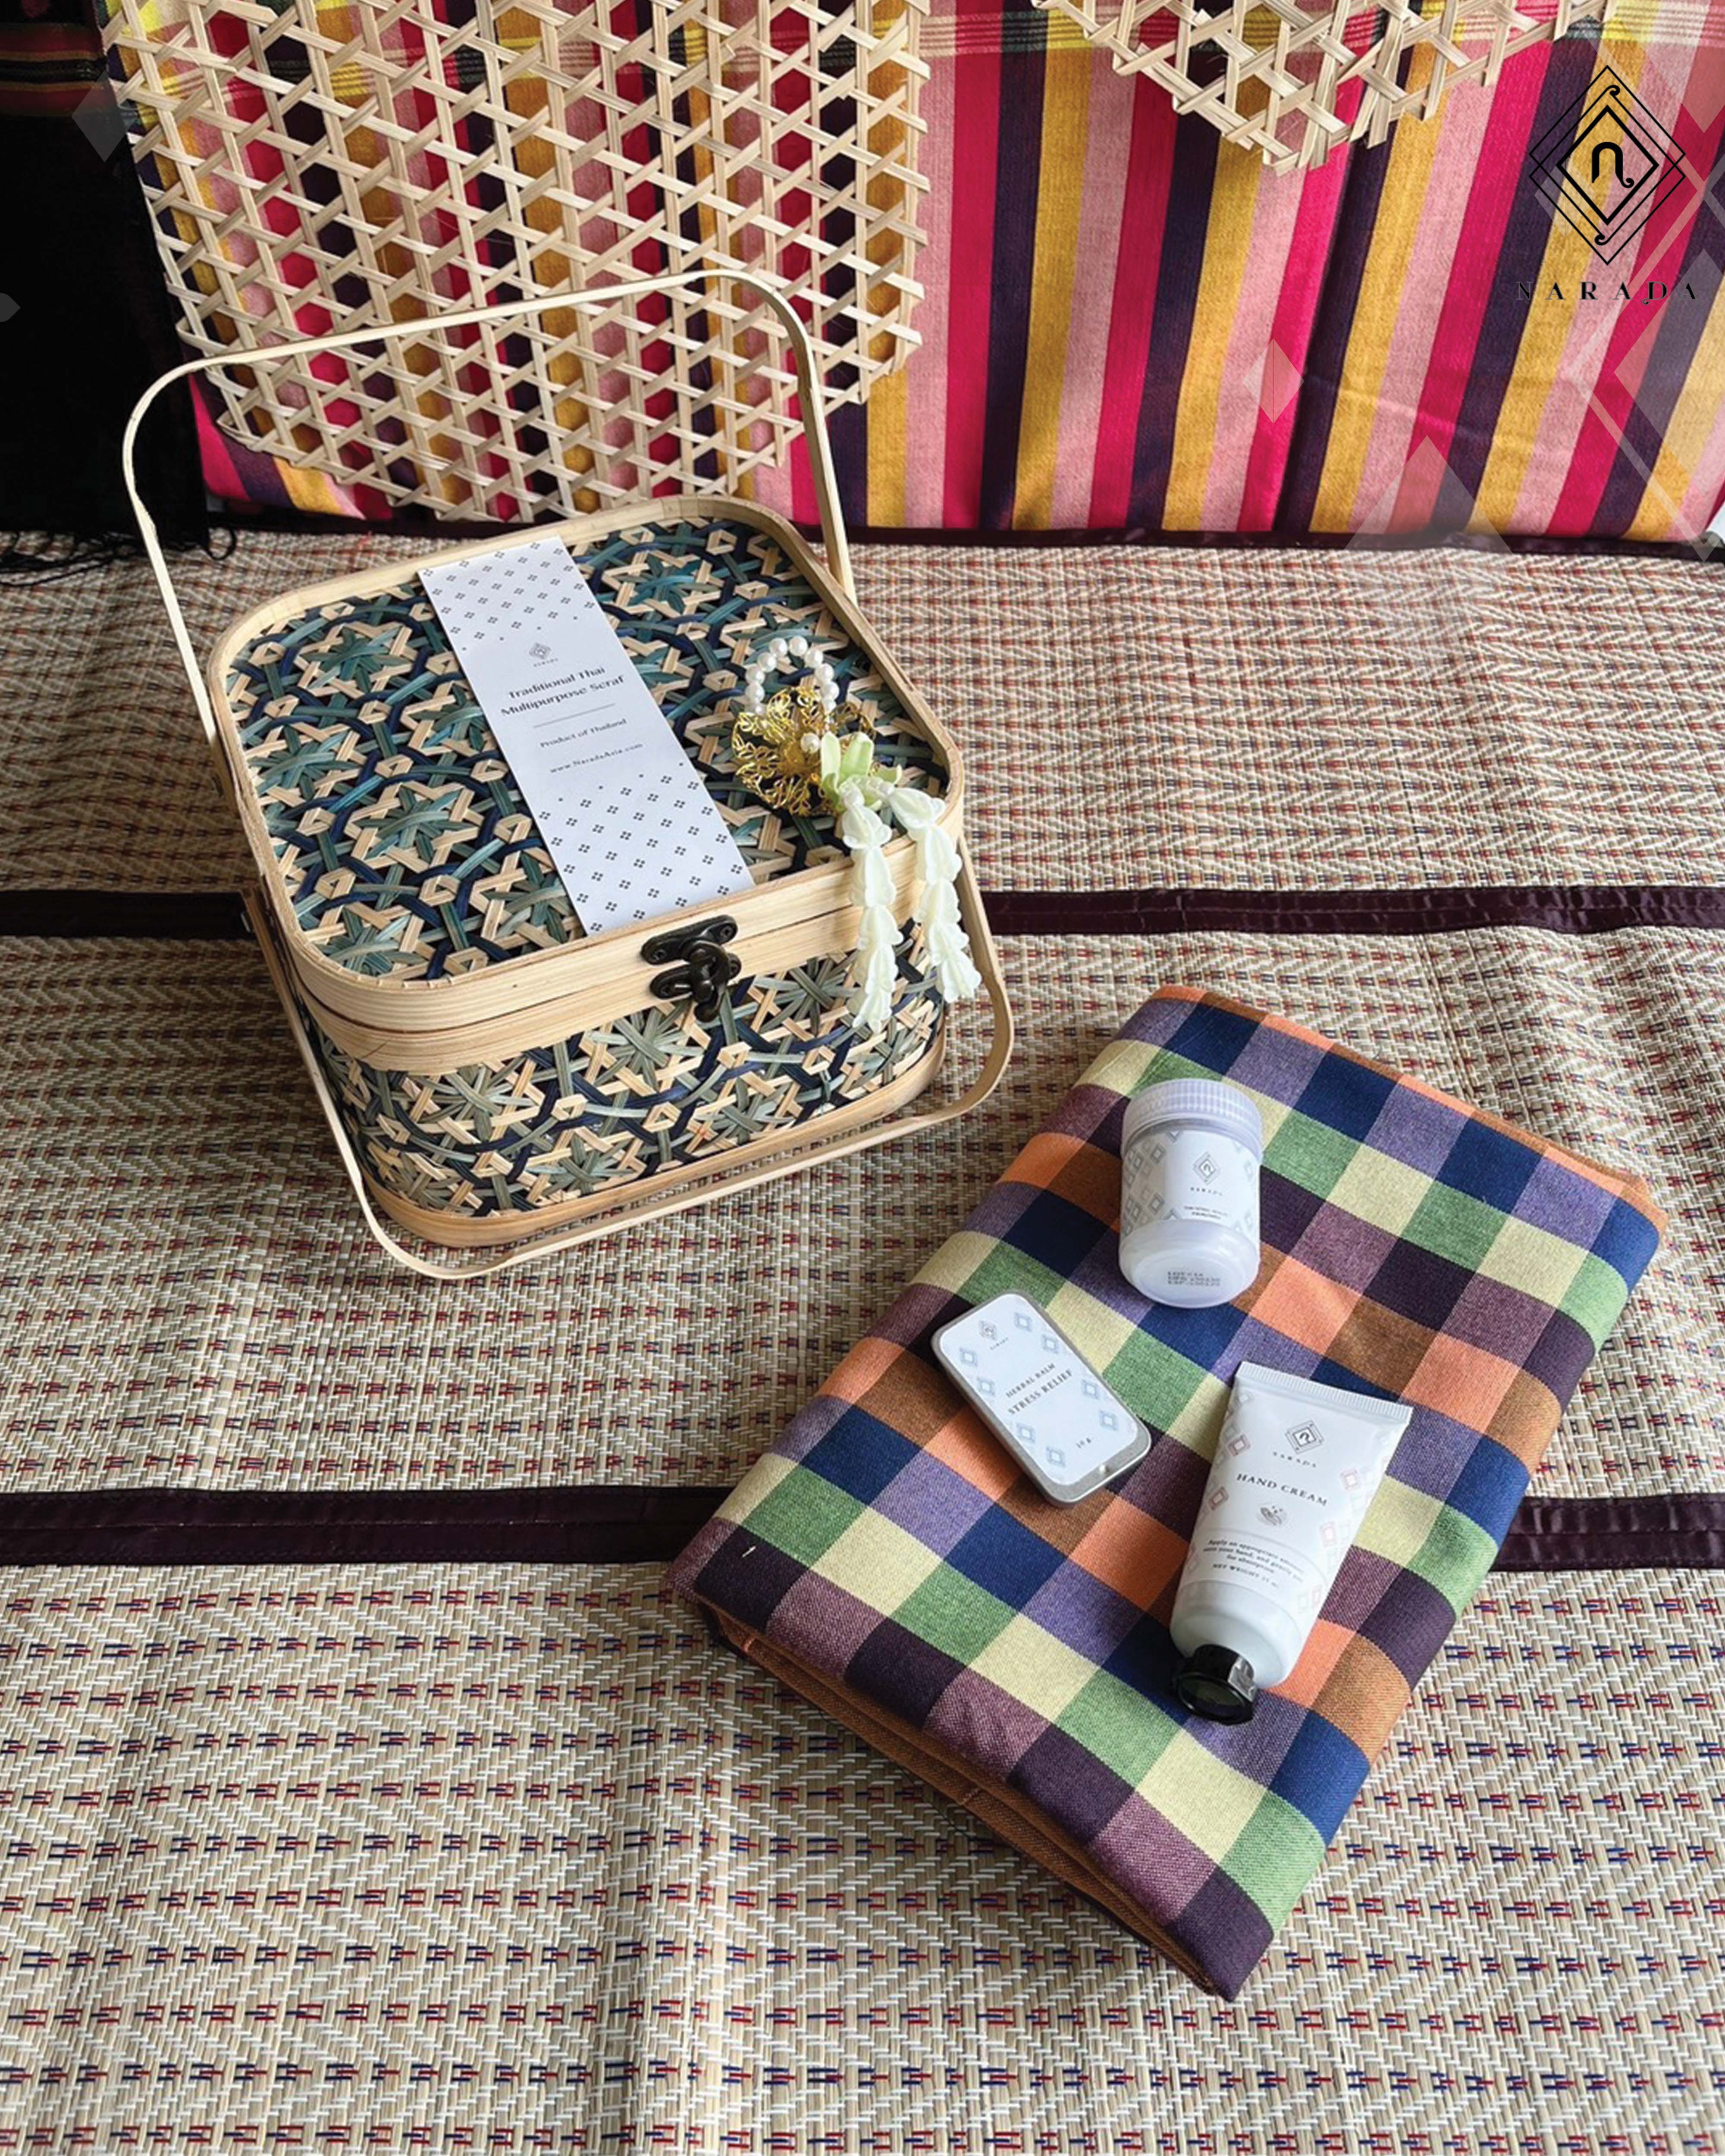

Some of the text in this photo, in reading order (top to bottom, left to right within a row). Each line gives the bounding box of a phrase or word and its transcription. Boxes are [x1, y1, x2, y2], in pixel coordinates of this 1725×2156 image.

[509, 666, 605, 699] Traditional Thai
[501, 687, 588, 716] Multipurpose
[540, 718, 627, 748] Product of Thailand
[1005, 1363, 1056, 1398] HERBAL BALM
[1008, 1369, 1073, 1414] STRESS RELIEF
[1236, 1473, 1327, 1506] HAND CREAM
